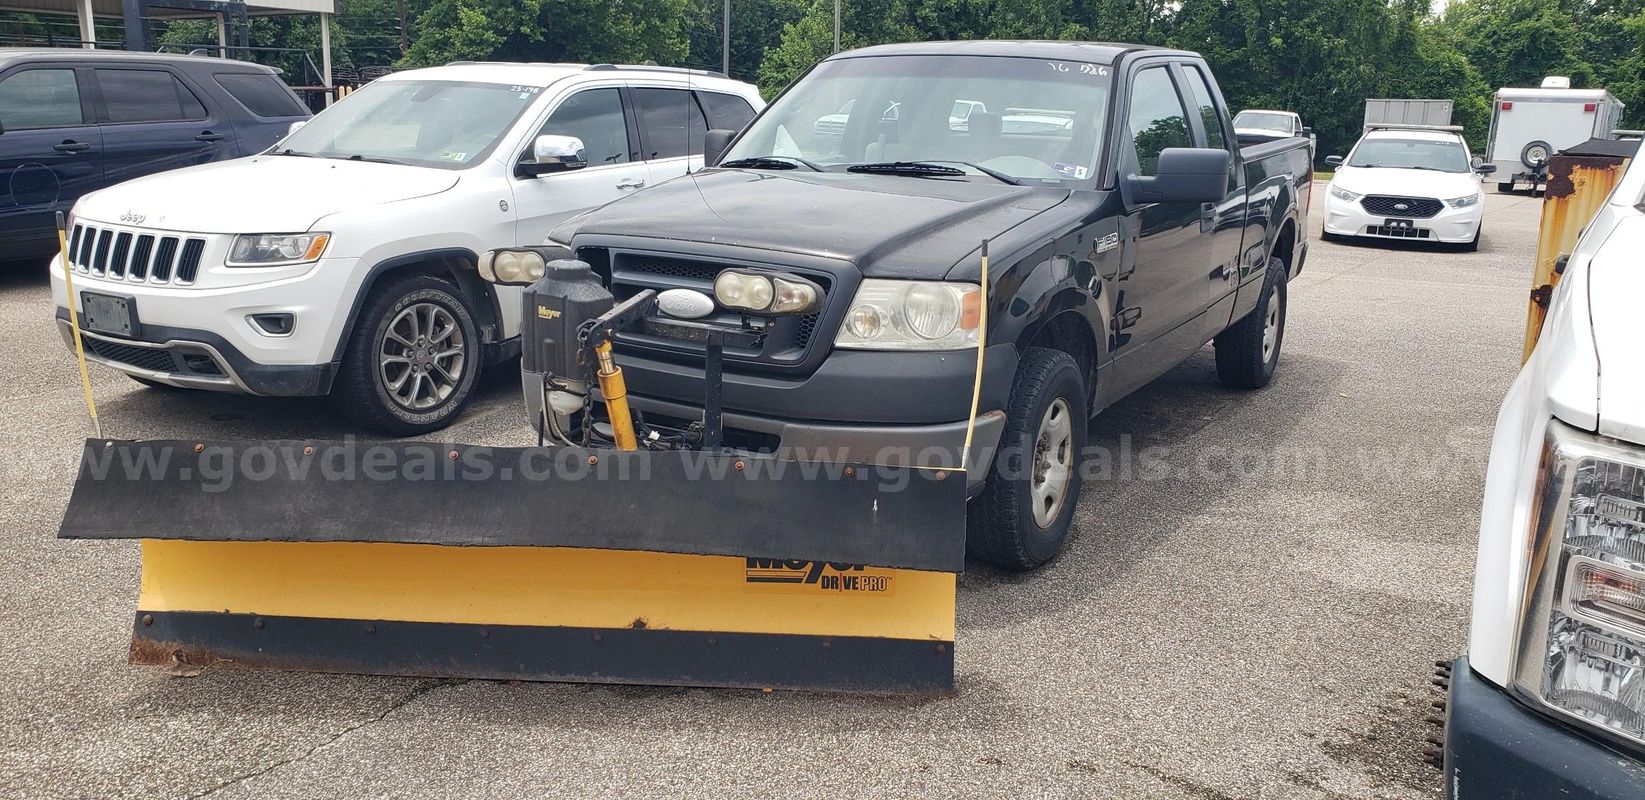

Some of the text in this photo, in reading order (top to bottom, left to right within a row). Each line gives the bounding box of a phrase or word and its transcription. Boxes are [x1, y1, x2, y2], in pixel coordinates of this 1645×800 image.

[120, 209, 146, 225] Jeep
[538, 305, 561, 319] Meyer
[821, 572, 859, 592] DRIVE
